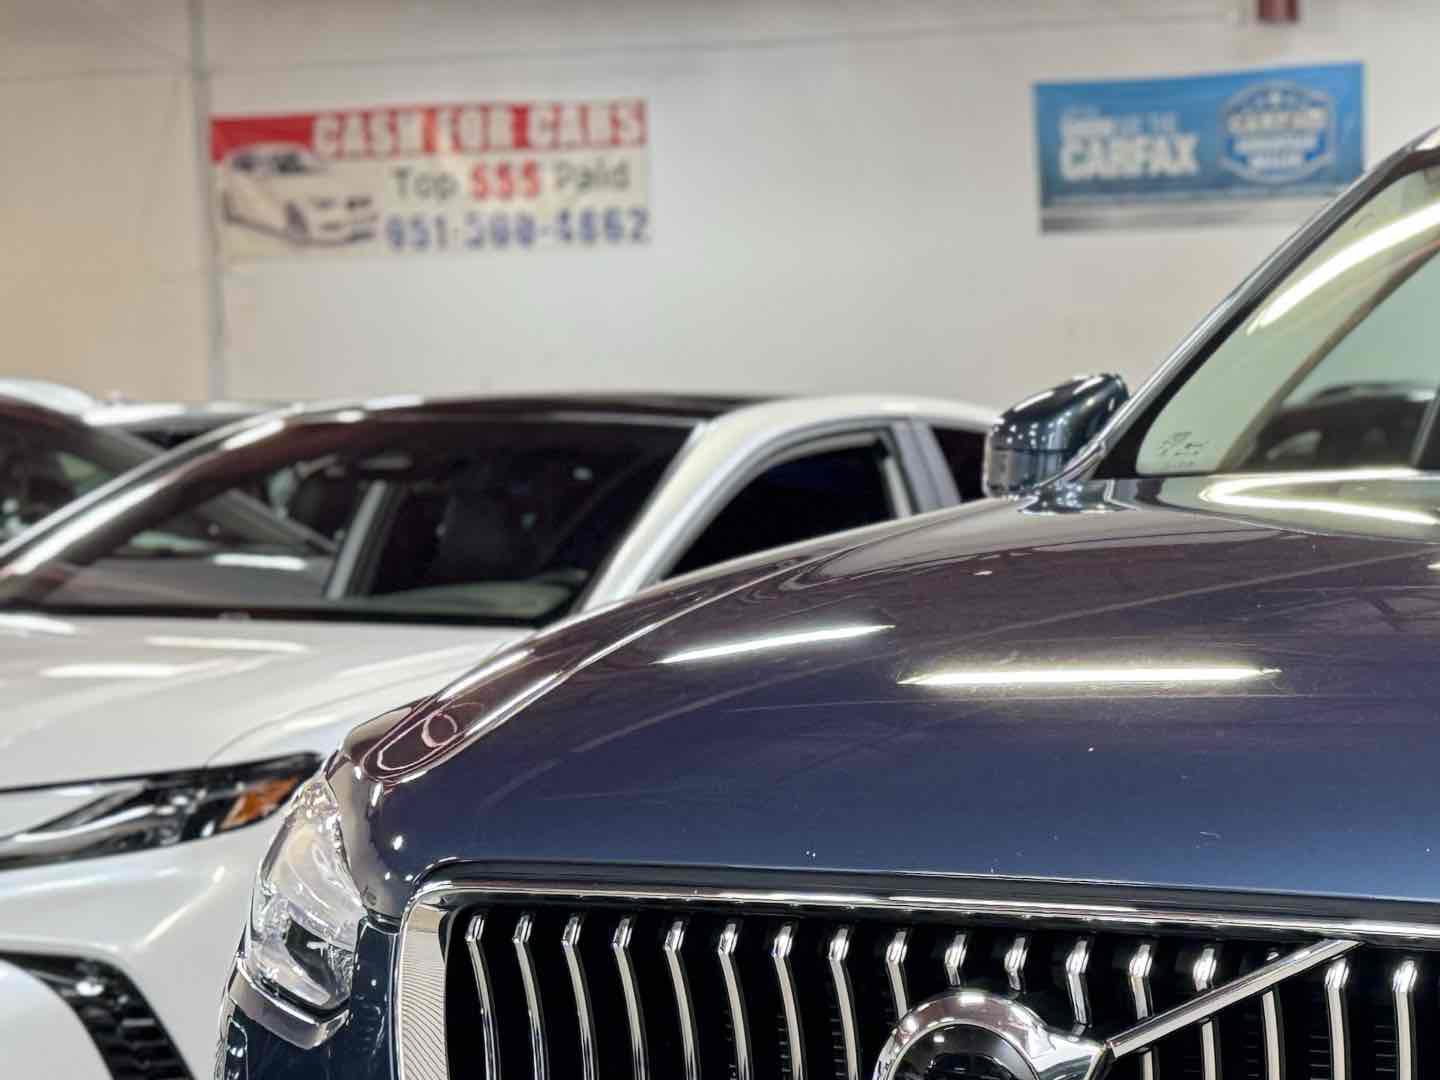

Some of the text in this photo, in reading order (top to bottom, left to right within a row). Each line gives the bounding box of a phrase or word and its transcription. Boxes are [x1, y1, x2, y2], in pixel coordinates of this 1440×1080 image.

[313, 101, 648, 161] CASH FOR CARS
[393, 163, 458, 201] Top
[553, 156, 630, 193] Paid
[1060, 133, 1198, 181] CARFAX
